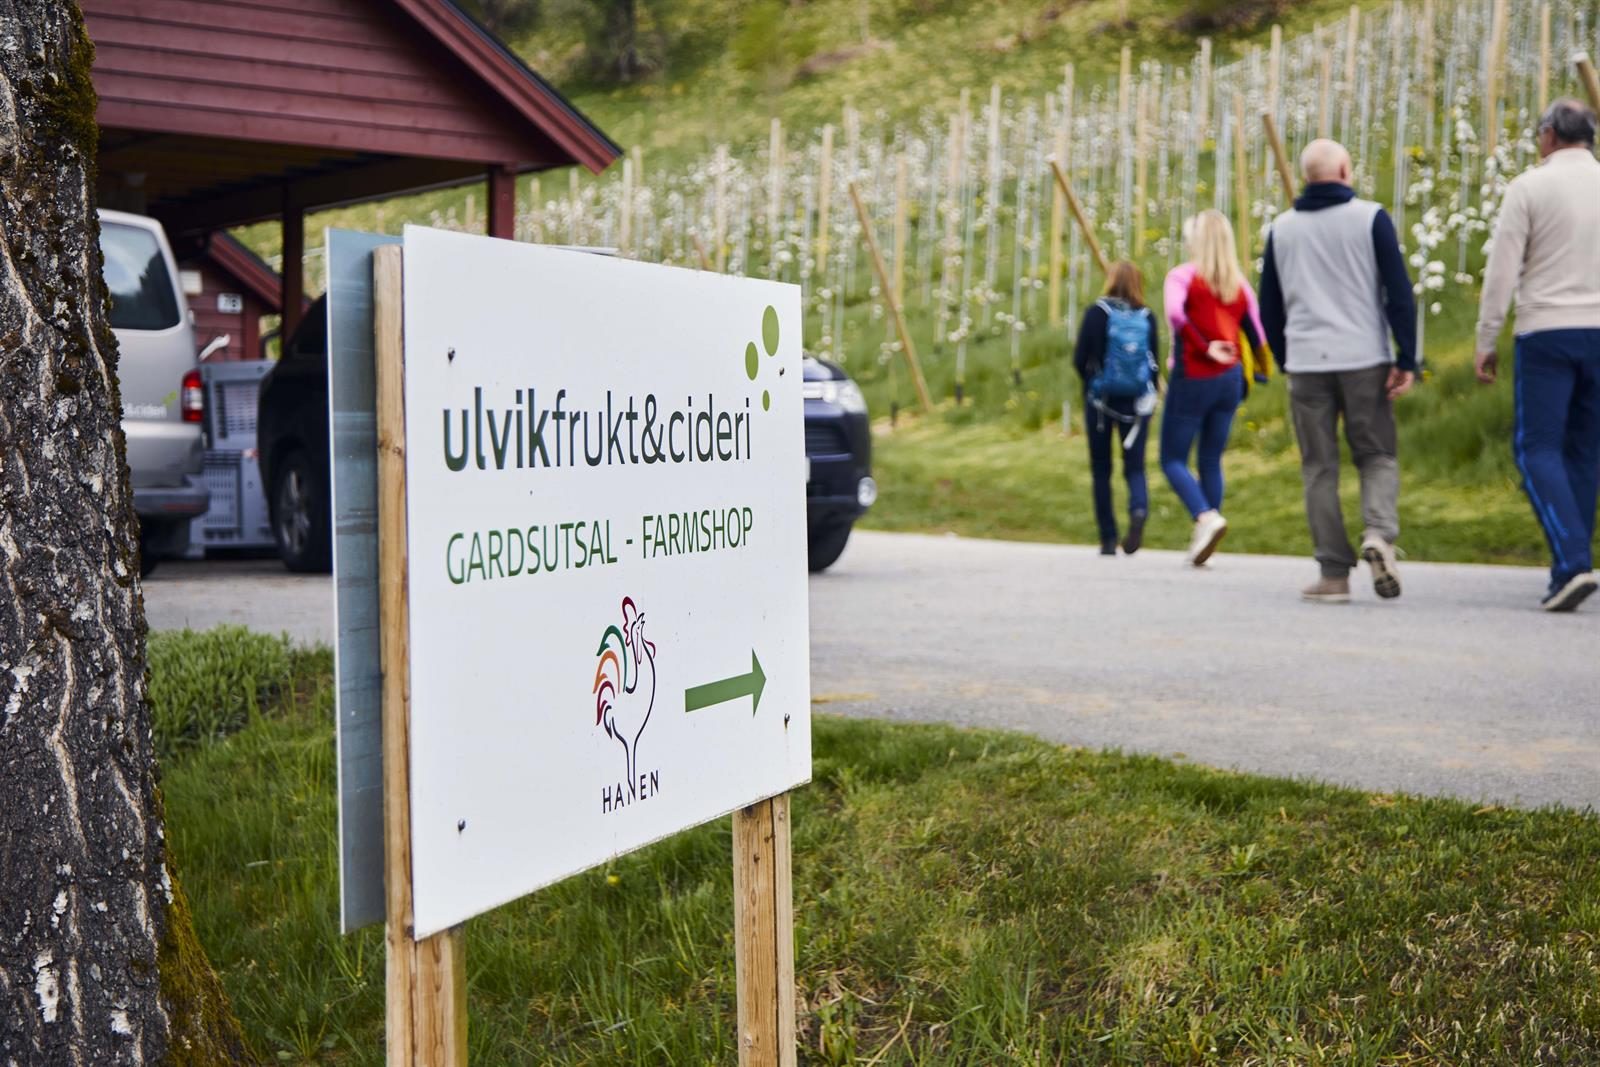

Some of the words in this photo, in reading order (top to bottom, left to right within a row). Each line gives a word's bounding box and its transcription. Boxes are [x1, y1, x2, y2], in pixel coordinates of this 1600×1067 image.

[442, 386, 752, 472] ulvikfrukt&cideri
[446, 519, 618, 585] GARDSUTSAL
[642, 506, 753, 560] FARMSHOP
[602, 769, 660, 815] HANEN
